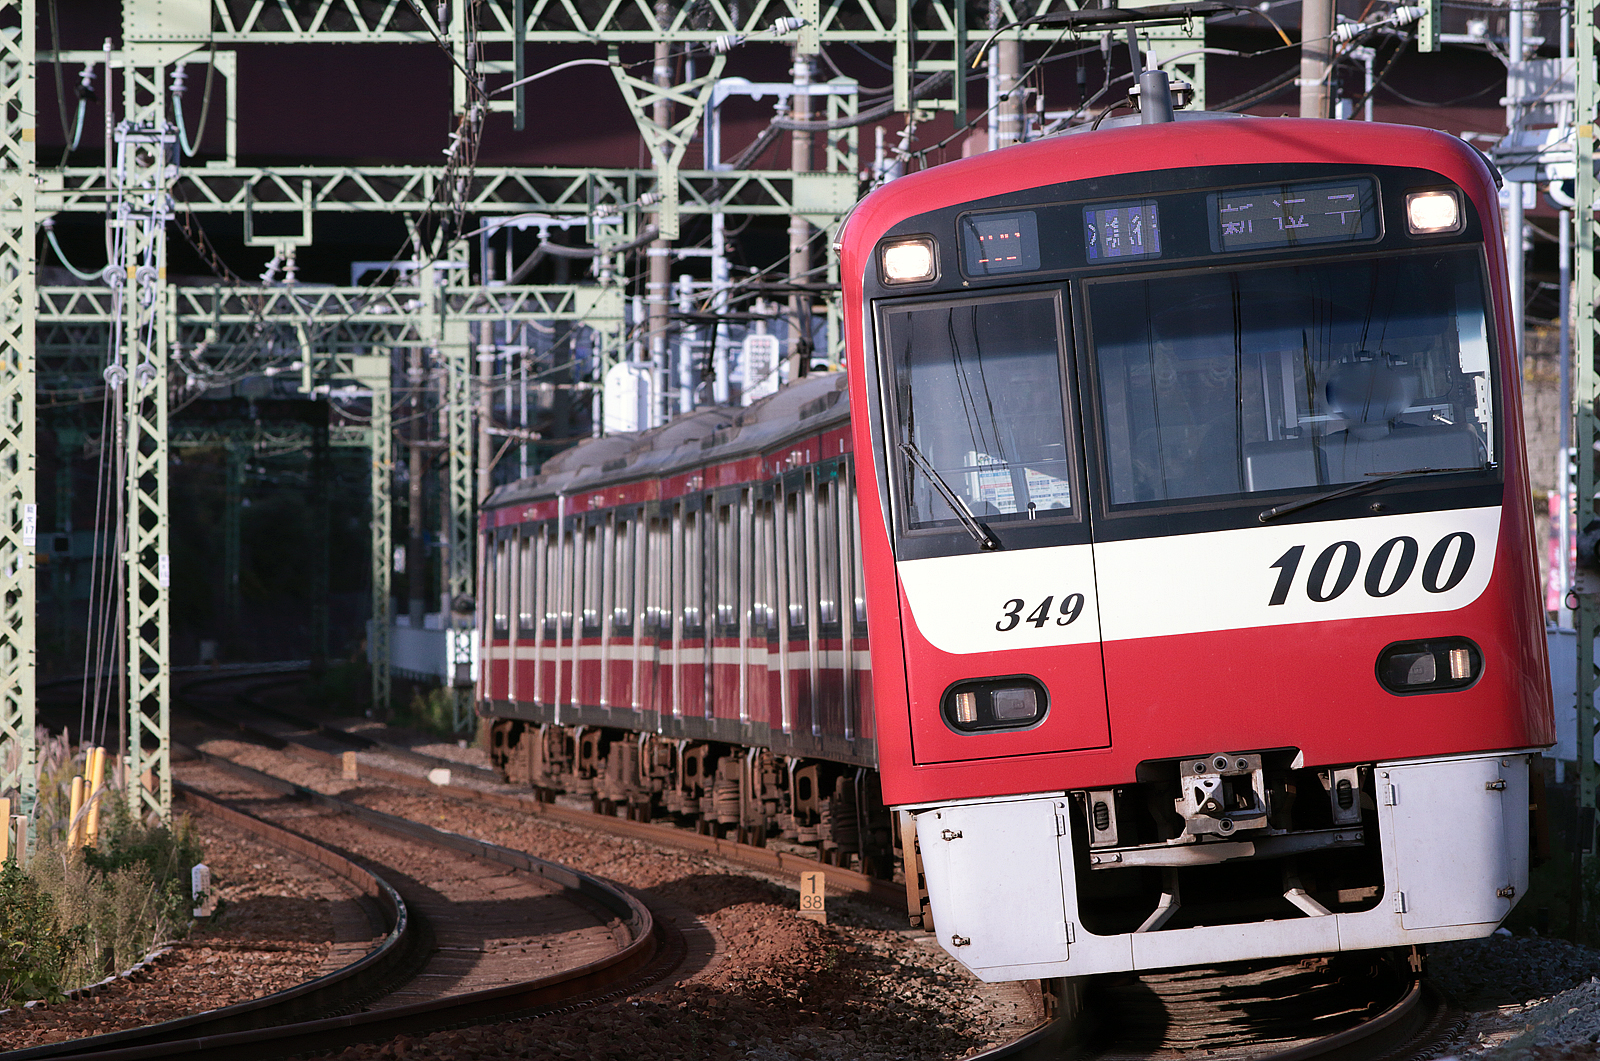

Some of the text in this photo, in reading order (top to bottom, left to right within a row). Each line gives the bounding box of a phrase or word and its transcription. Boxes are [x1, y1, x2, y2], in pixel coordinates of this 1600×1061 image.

[1268, 532, 1476, 606] 1000
[995, 593, 1085, 632] 349
[807, 874, 816, 894] 1
[803, 895, 823, 909] 38
